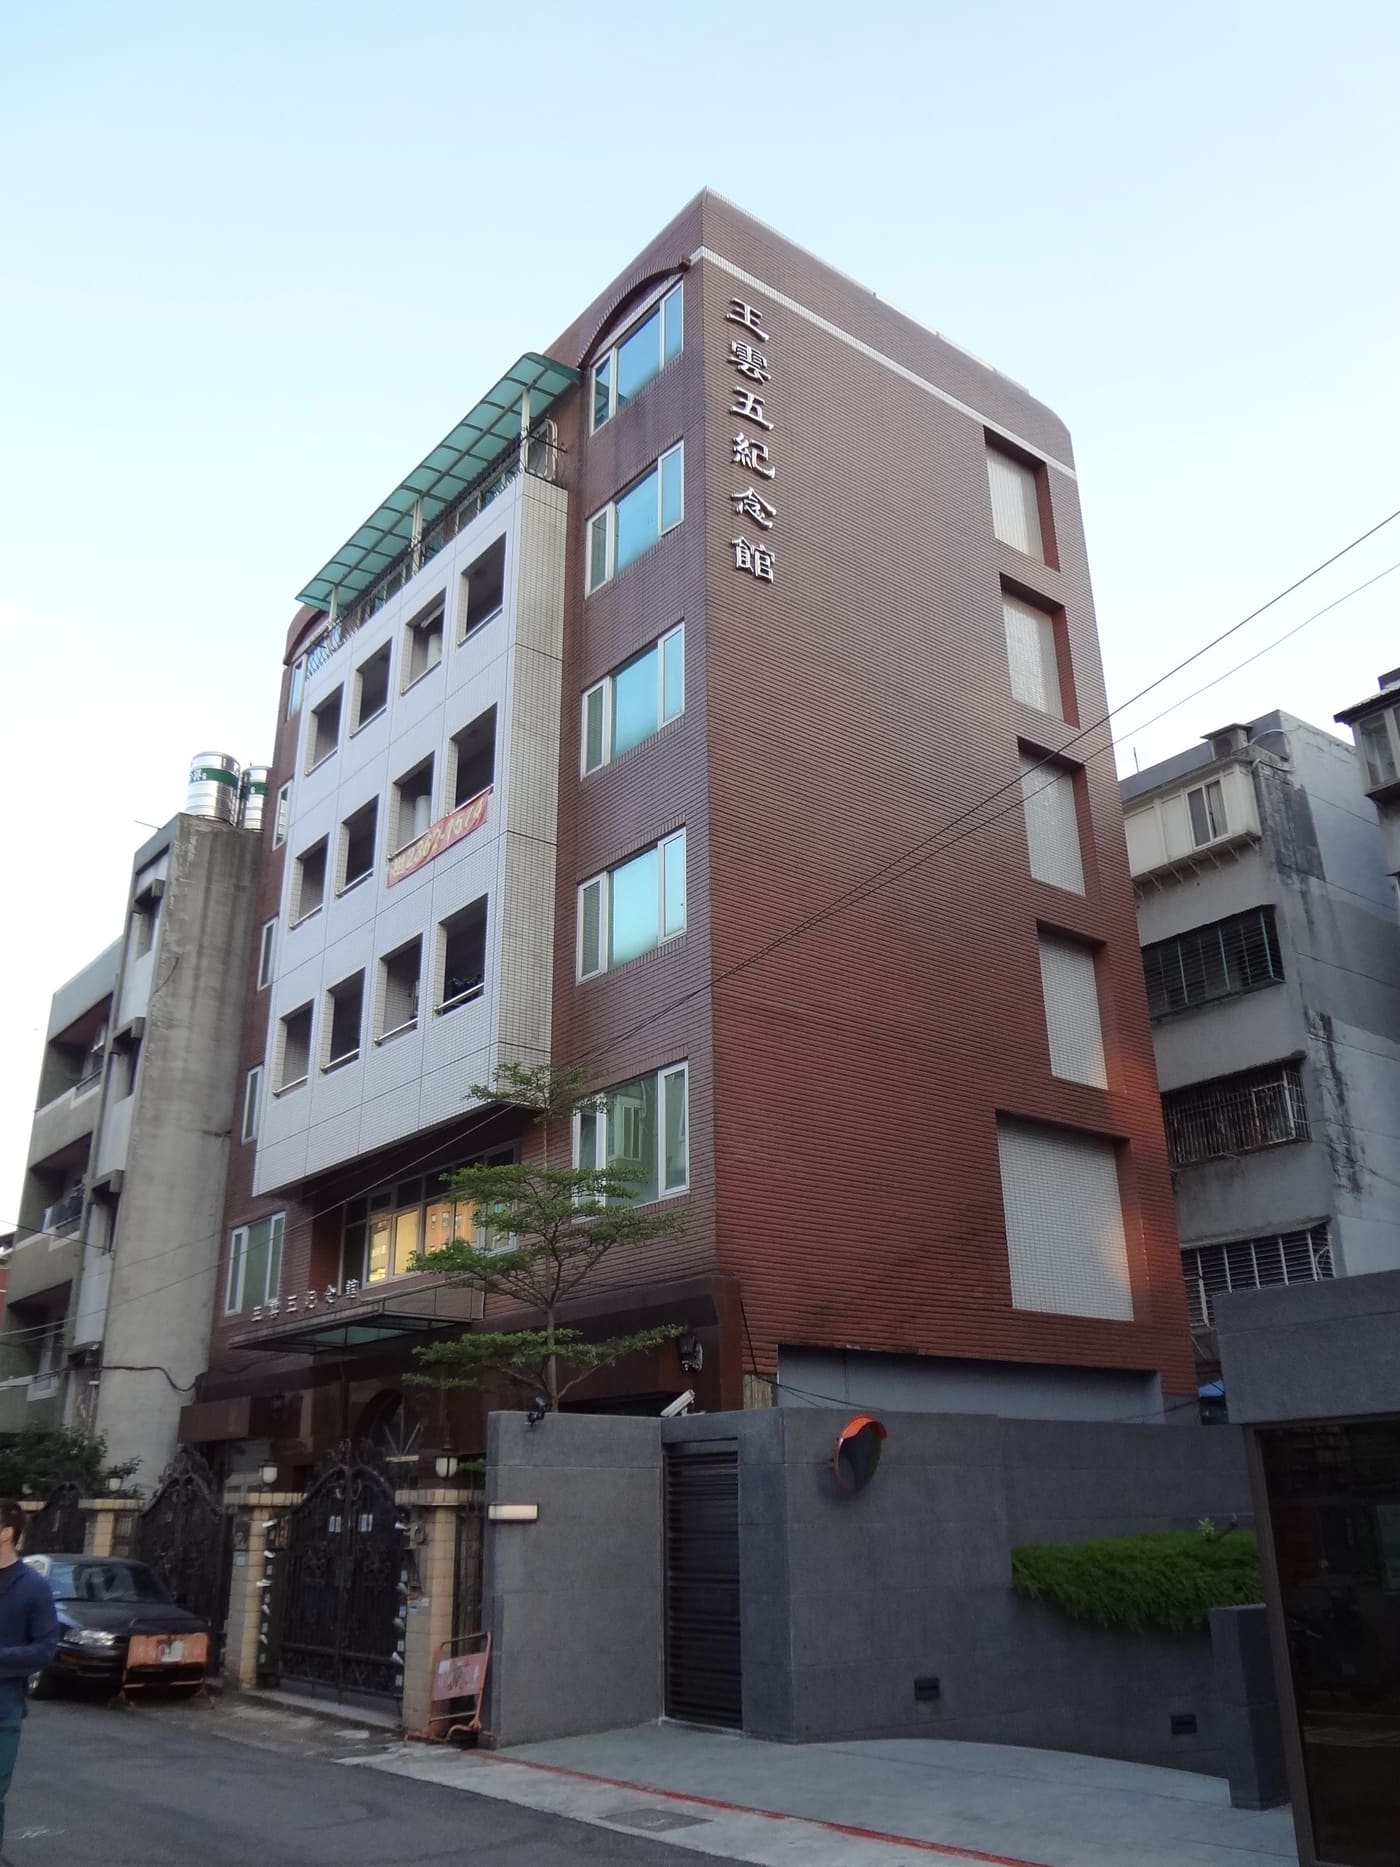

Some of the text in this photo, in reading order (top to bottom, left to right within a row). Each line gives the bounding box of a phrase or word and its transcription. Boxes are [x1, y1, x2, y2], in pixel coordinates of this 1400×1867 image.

[726, 298, 777, 583] 王雲五紀念館
